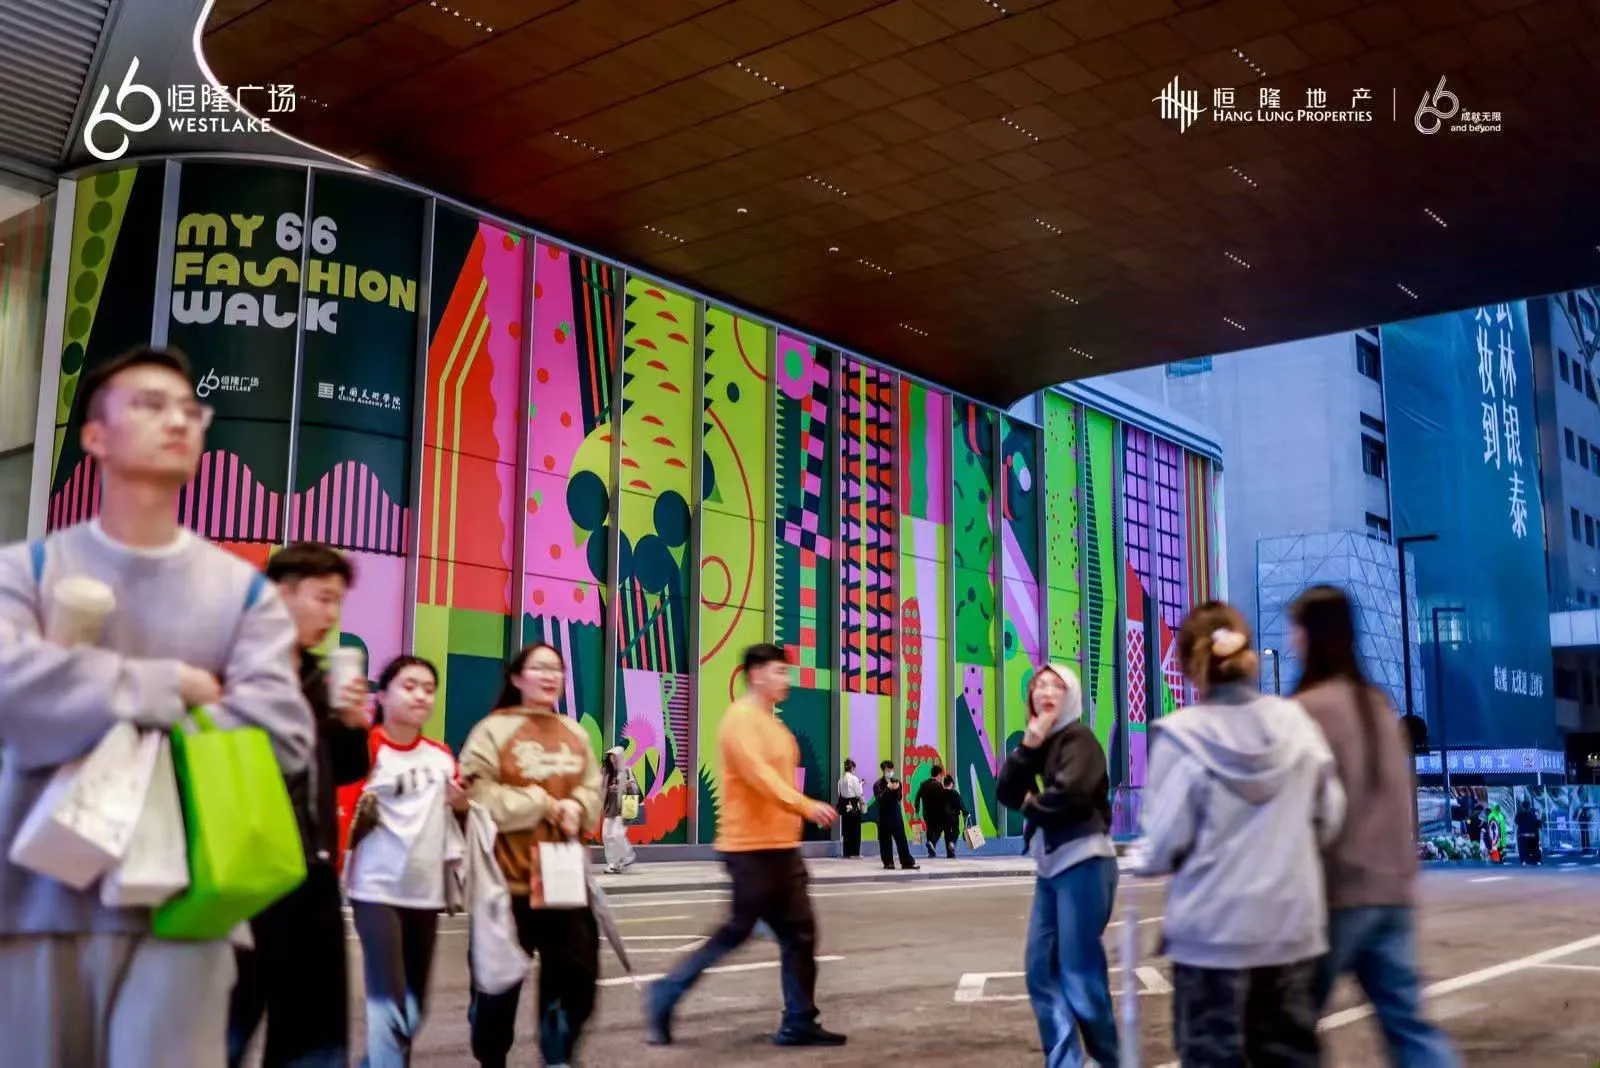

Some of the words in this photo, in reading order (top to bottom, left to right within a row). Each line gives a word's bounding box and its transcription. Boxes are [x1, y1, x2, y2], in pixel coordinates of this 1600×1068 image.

[177, 212, 264, 247] MY
[275, 212, 338, 255] 66
[174, 252, 417, 313] FASHION
[171, 291, 339, 335] WALK
